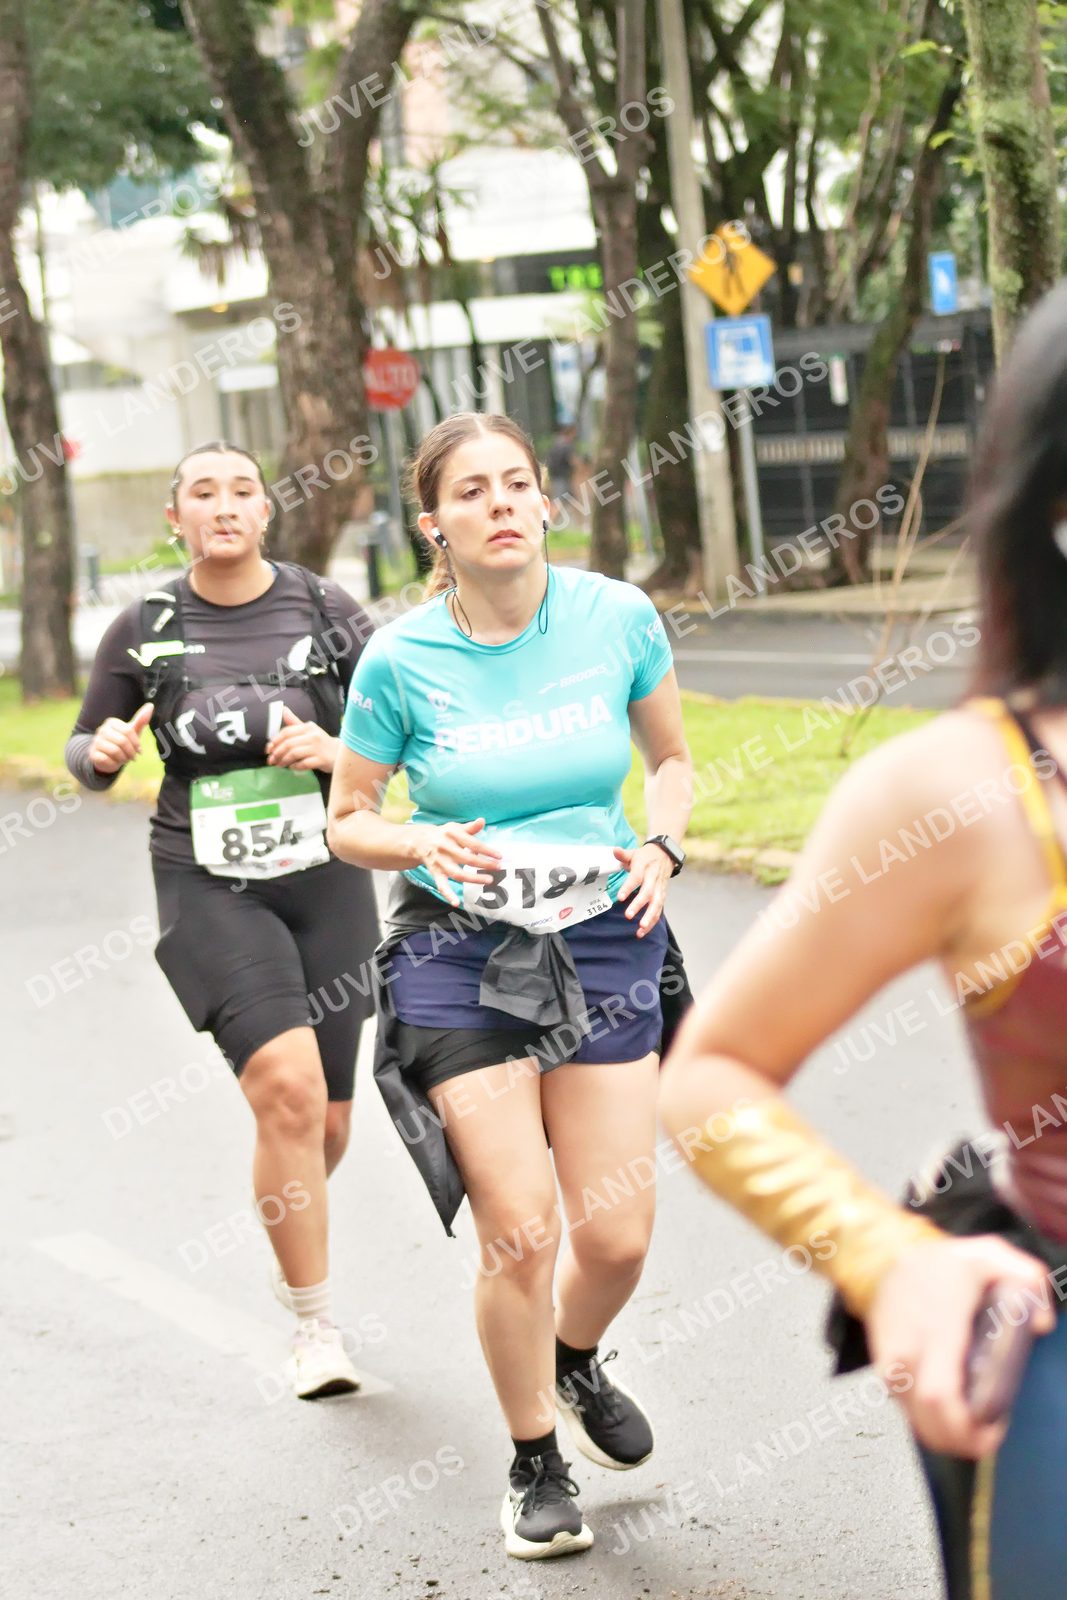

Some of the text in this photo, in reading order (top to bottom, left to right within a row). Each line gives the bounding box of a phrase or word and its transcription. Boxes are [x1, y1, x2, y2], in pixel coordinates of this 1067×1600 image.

[560, 664, 608, 688] BROOKS
[434, 694, 613, 754] PERDURA
[221, 820, 303, 863] 854
